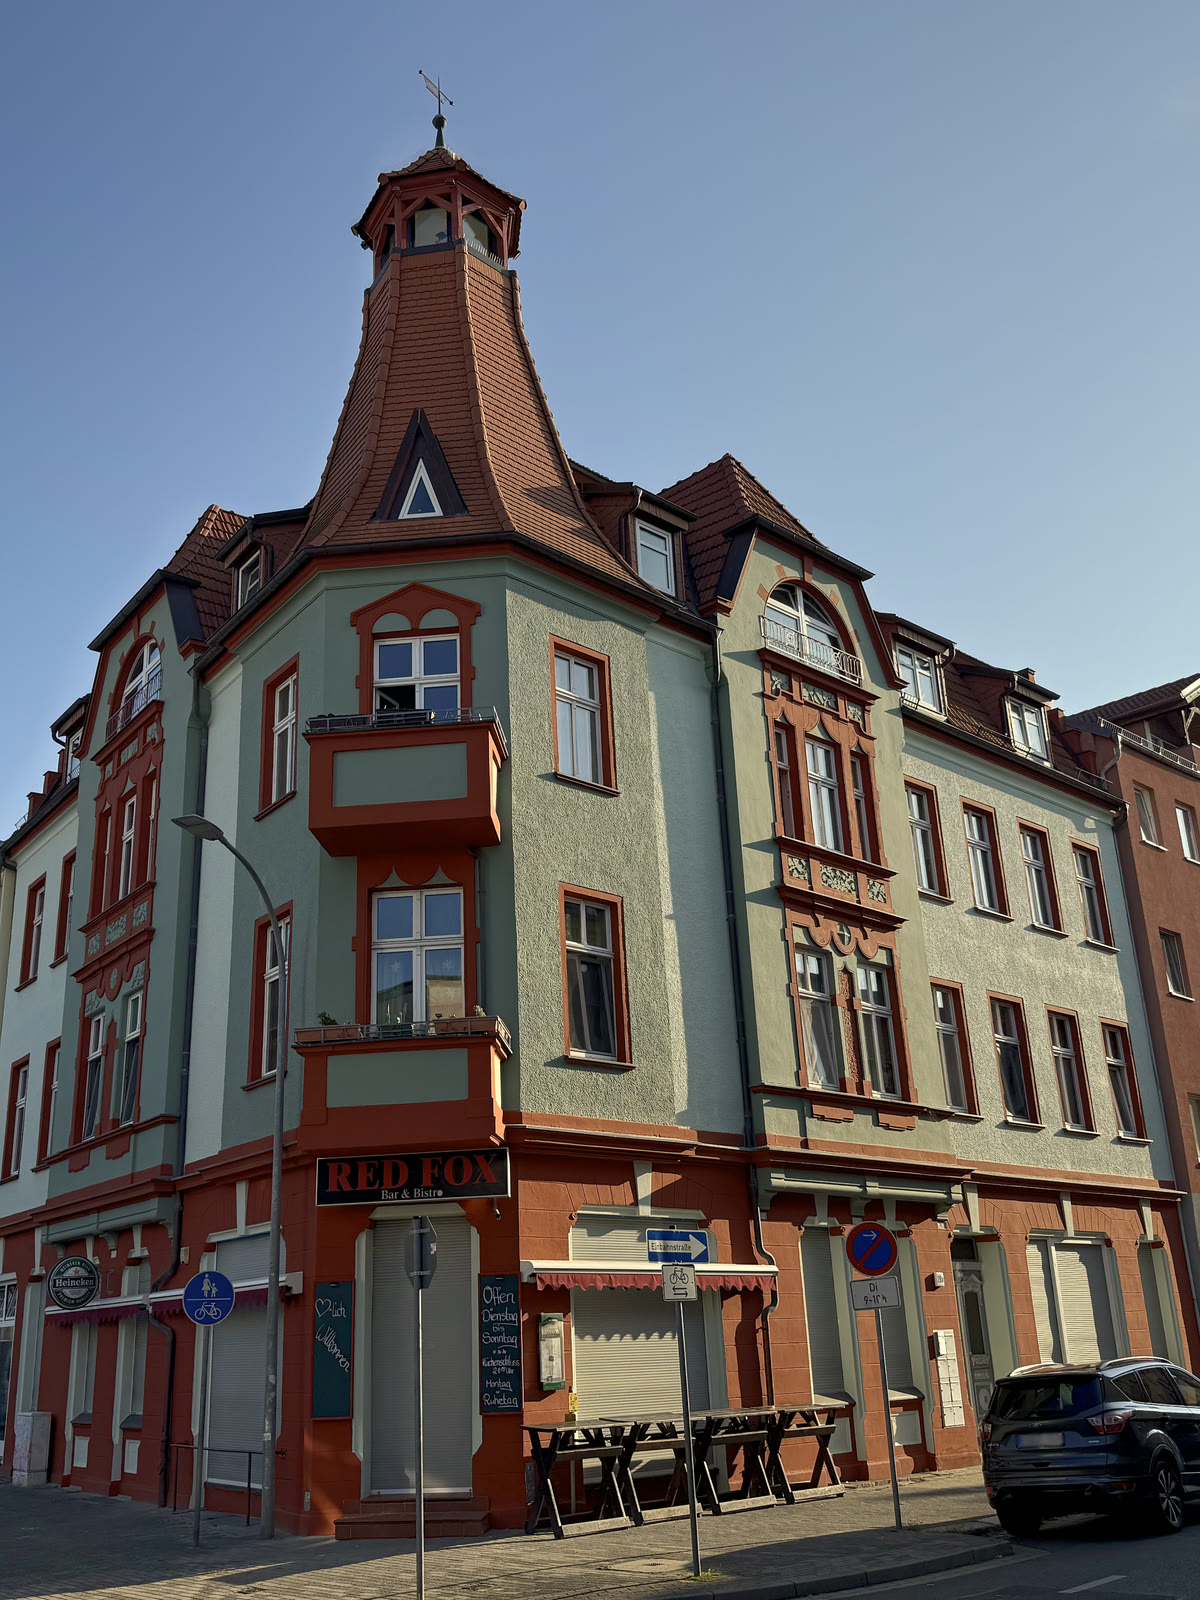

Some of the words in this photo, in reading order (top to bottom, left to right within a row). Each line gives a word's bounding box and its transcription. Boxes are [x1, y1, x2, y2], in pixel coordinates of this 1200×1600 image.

[326, 1159, 408, 1192] RED
[420, 1154, 497, 1188] FOX
[381, 1189, 399, 1200] Bar
[401, 1188, 410, 1199] &
[413, 1187, 443, 1198] Bistro
[55, 1277, 94, 1287] Heineken
[869, 1282, 878, 1292] Di
[483, 1285, 515, 1306] Offen
[481, 1306, 518, 1326] Dienstag
[492, 1324, 505, 1333] bis
[482, 1332, 518, 1348] Sonntag
[485, 1378, 512, 1391] Montag
